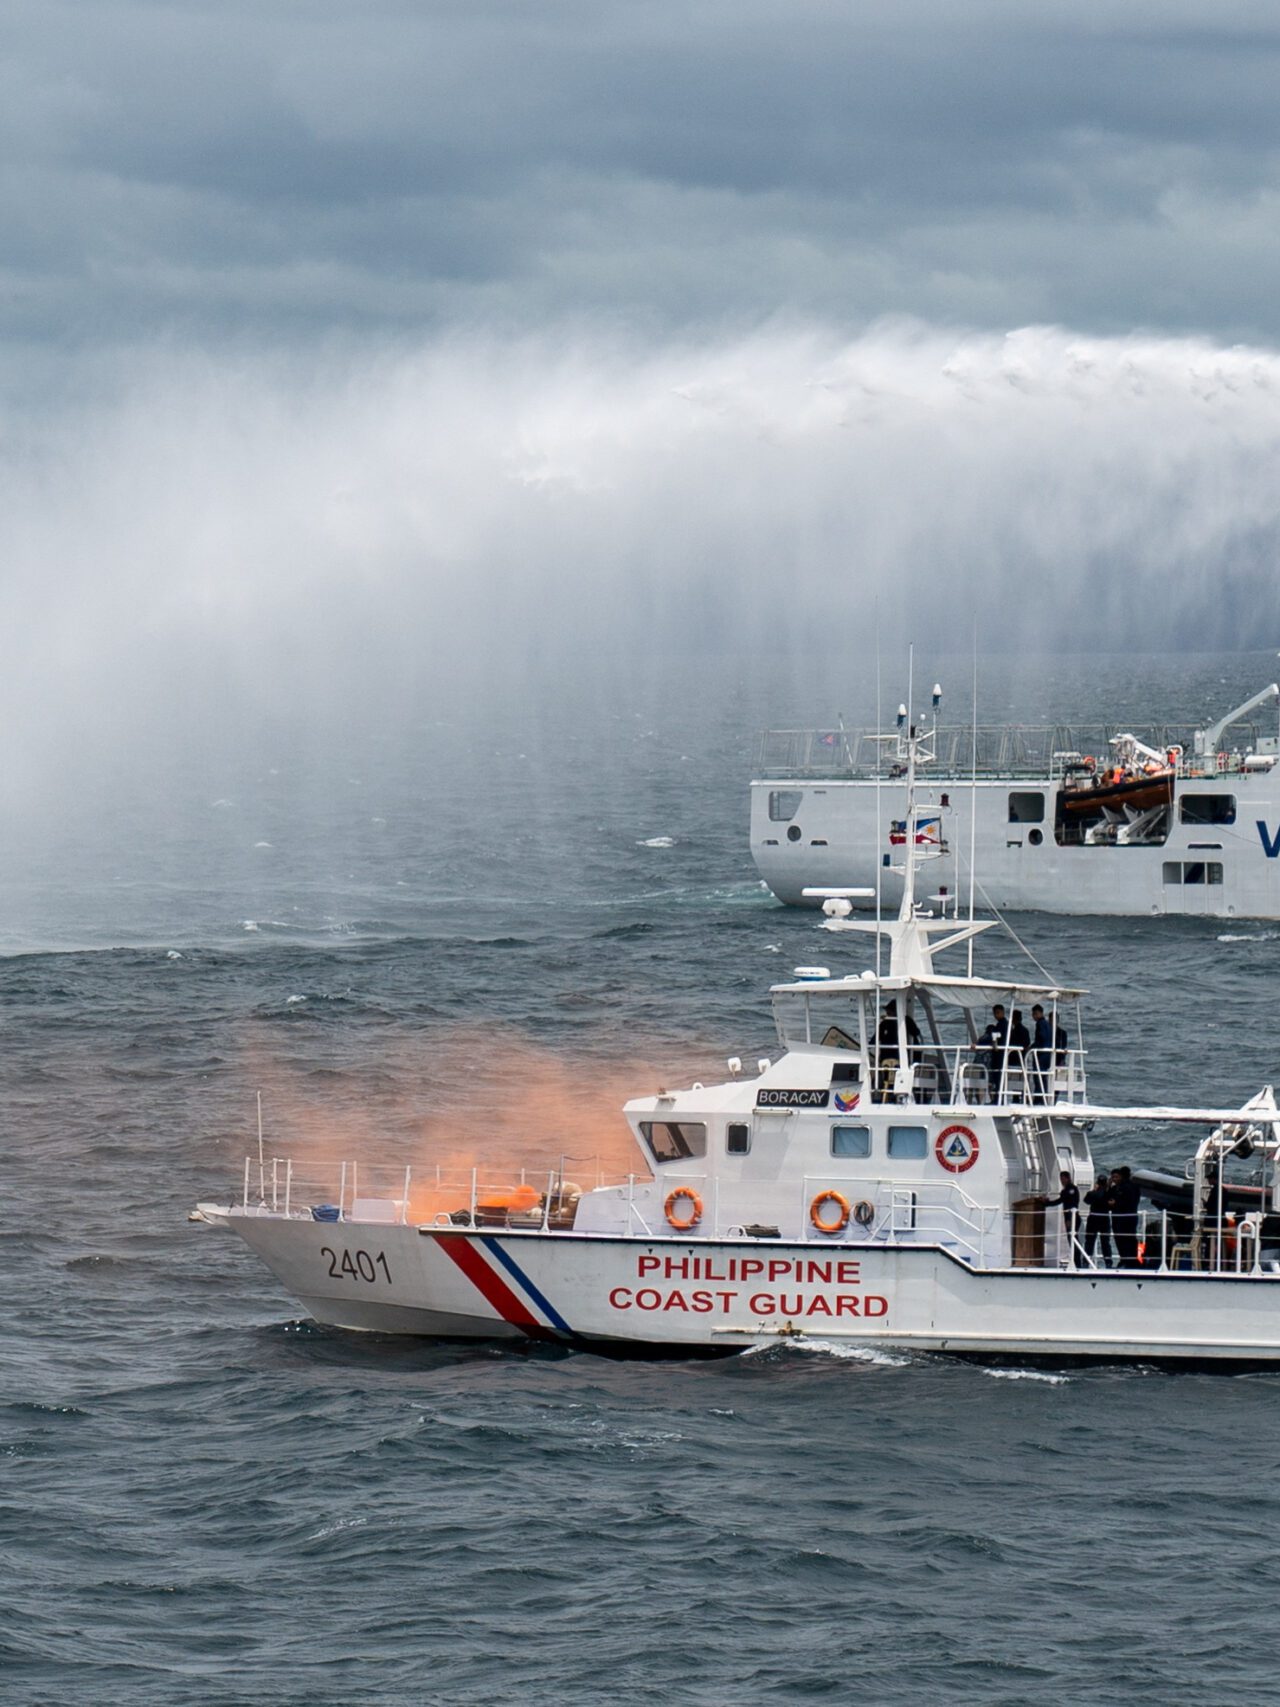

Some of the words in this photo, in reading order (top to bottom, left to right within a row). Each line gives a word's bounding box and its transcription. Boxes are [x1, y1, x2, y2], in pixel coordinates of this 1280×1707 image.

[759, 1090, 826, 1104] BORACAY
[321, 1247, 392, 1284] 2401
[638, 1256, 861, 1284] PHILIPPINE
[609, 1288, 737, 1314] COAST
[749, 1294, 888, 1317] GUARD
